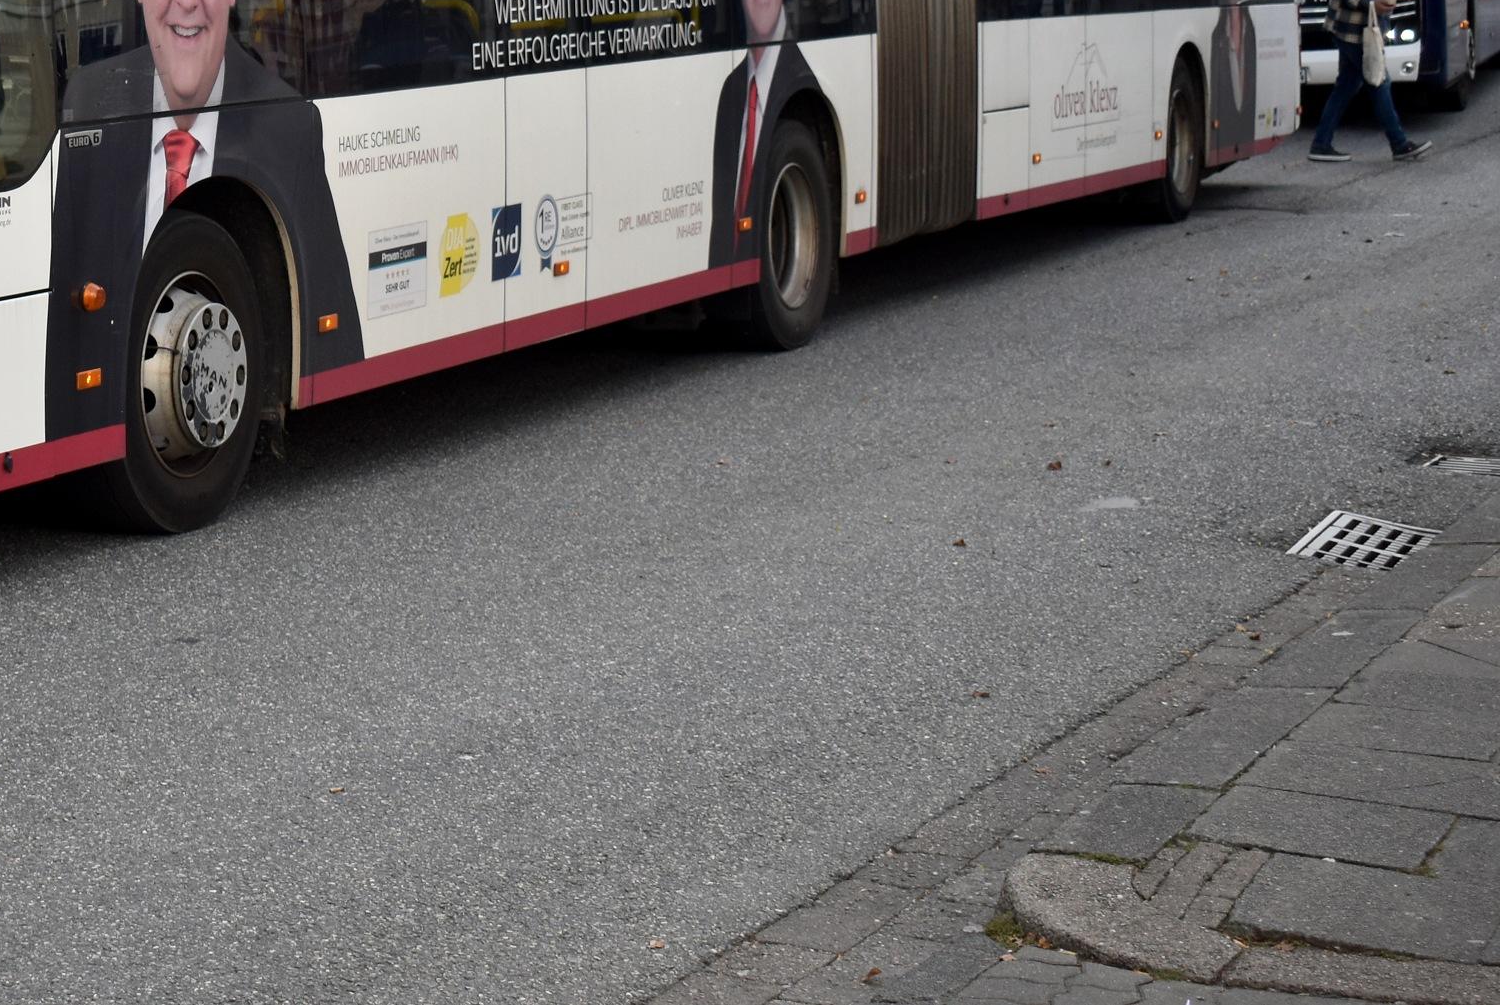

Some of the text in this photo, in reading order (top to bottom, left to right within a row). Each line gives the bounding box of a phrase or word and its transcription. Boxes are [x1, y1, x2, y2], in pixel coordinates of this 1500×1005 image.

[472, 40, 505, 71] EINE
[508, 29, 606, 67] ERFOLGREICHE
[68, 132, 100, 148] EURO 6
[338, 125, 421, 153] HAUKE SCHMELING
[338, 144, 459, 179] IMMOBILIENKAUFMANN (IHK)
[494, 230, 519, 258] ivd
[443, 256, 463, 279] Zert
